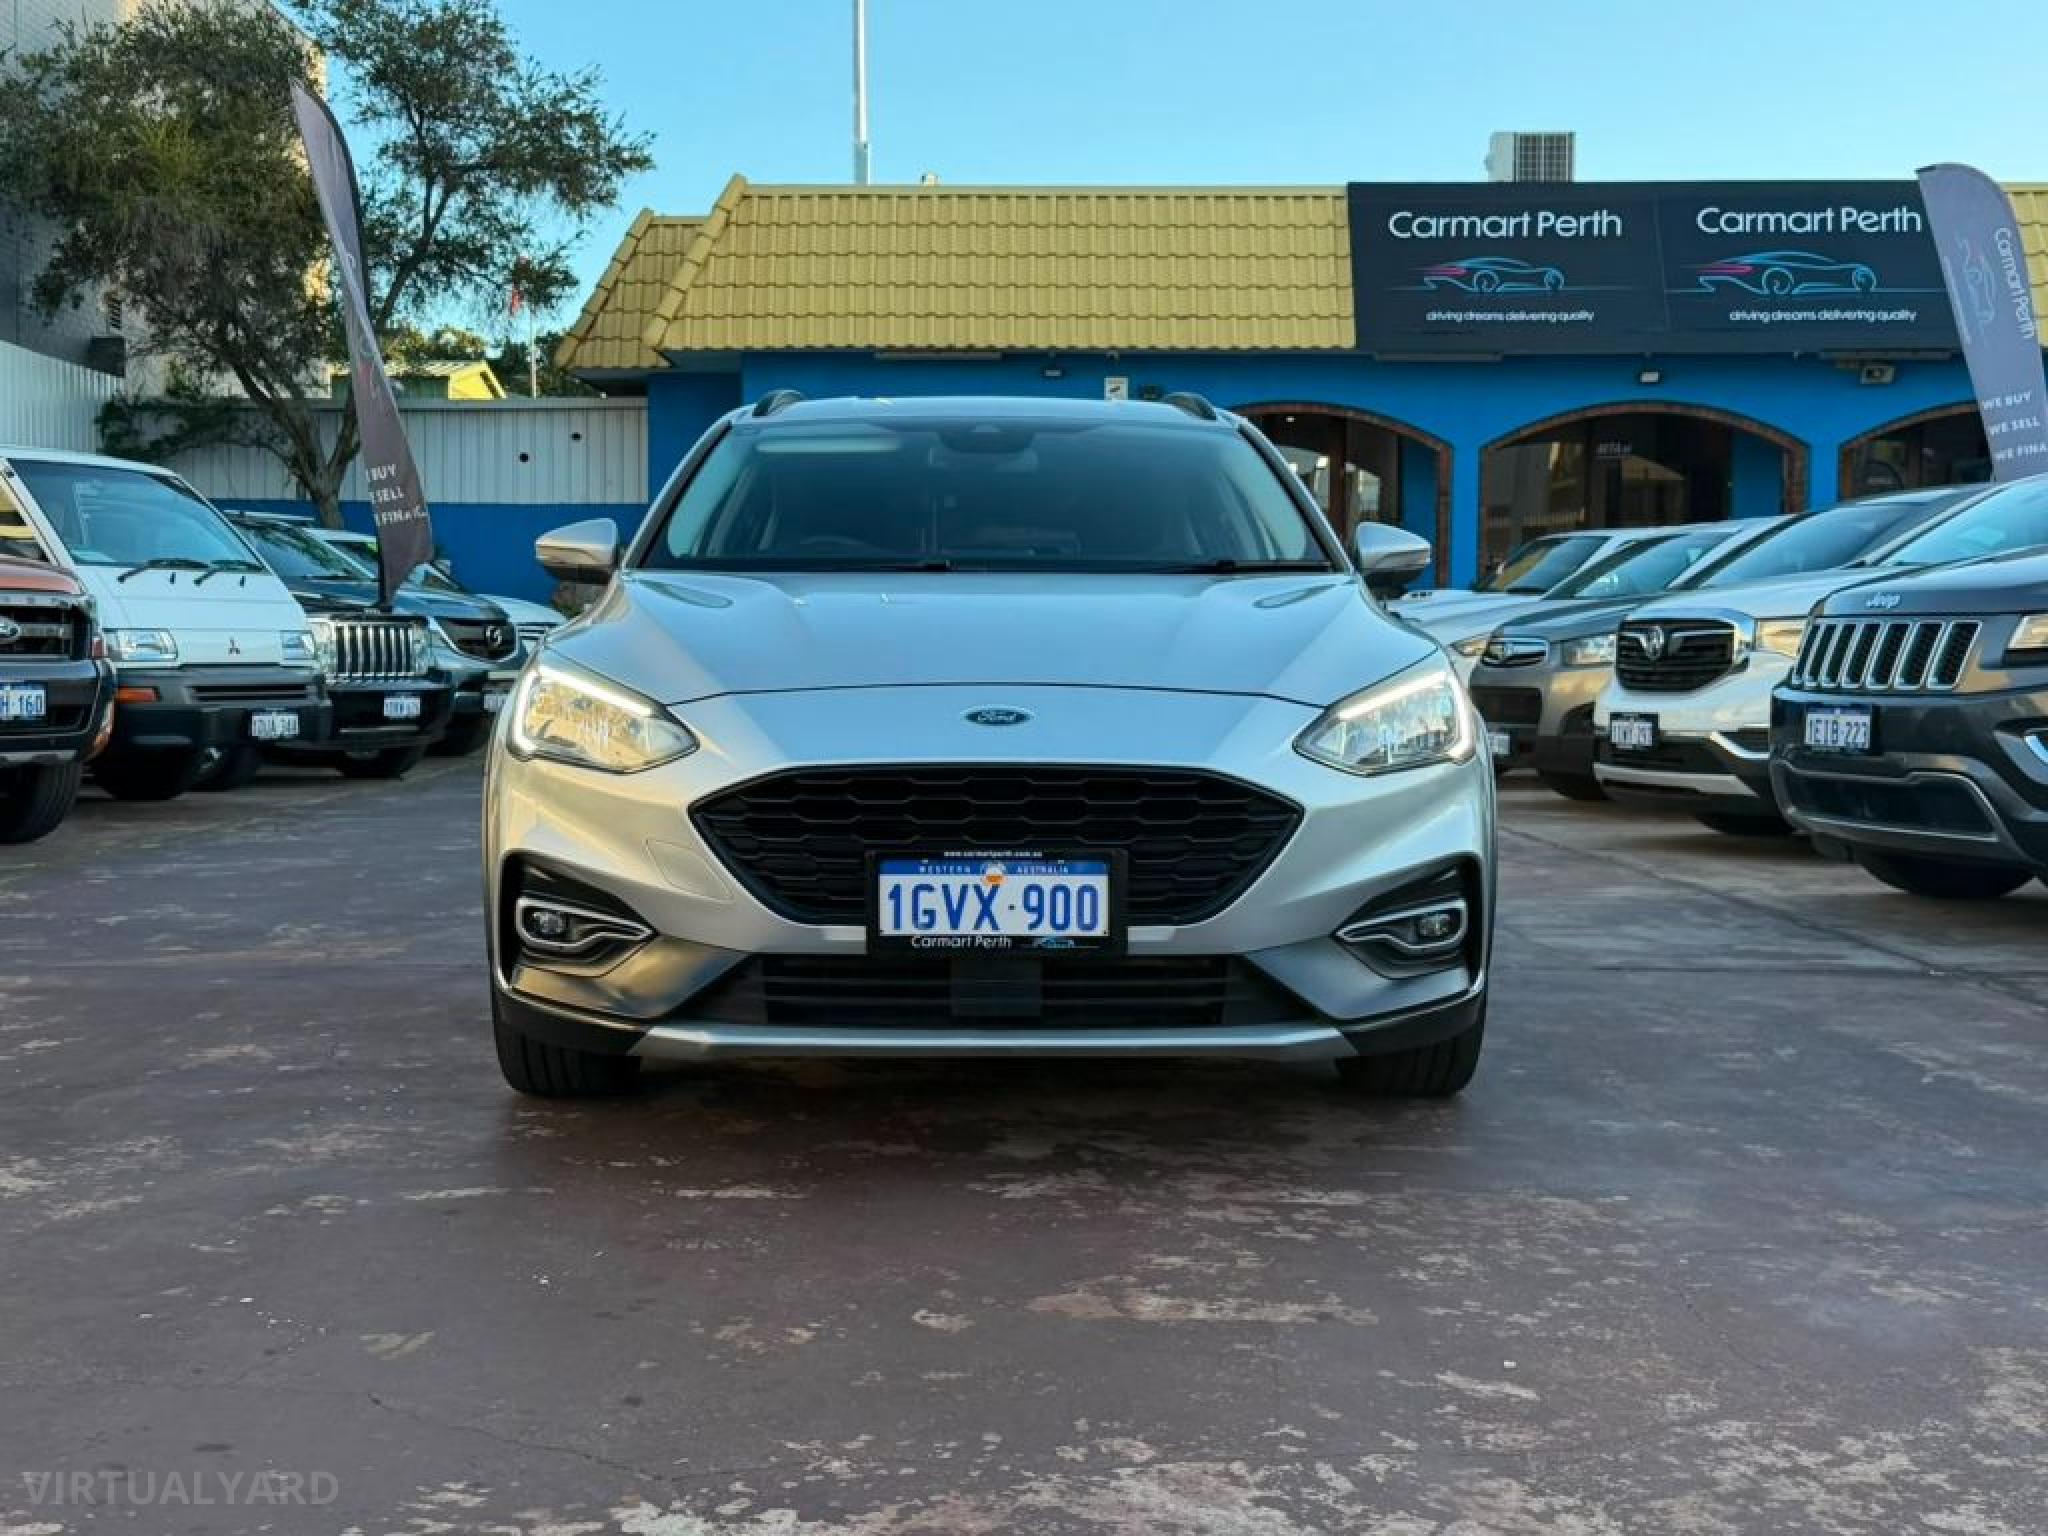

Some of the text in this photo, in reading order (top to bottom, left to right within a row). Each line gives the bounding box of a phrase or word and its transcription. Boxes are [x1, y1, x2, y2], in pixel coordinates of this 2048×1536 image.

[1388, 209, 1623, 239] Carmart Perth
[1696, 205, 1922, 234] Carmart Perth
[1995, 227, 2035, 339] Carmart Perth
[1425, 309, 1595, 323] driving dreams delivering quality
[1729, 309, 1917, 323] driving dreams delivering quality
[1982, 391, 2032, 411] WE BUY
[2011, 416, 2041, 431] SELL
[371, 463, 397, 481] BUY
[1866, 593, 1901, 609] Jeep
[919, 865, 1069, 874] WESTERN AUSTRALIA
[911, 934, 1012, 948] Carmart Perth
